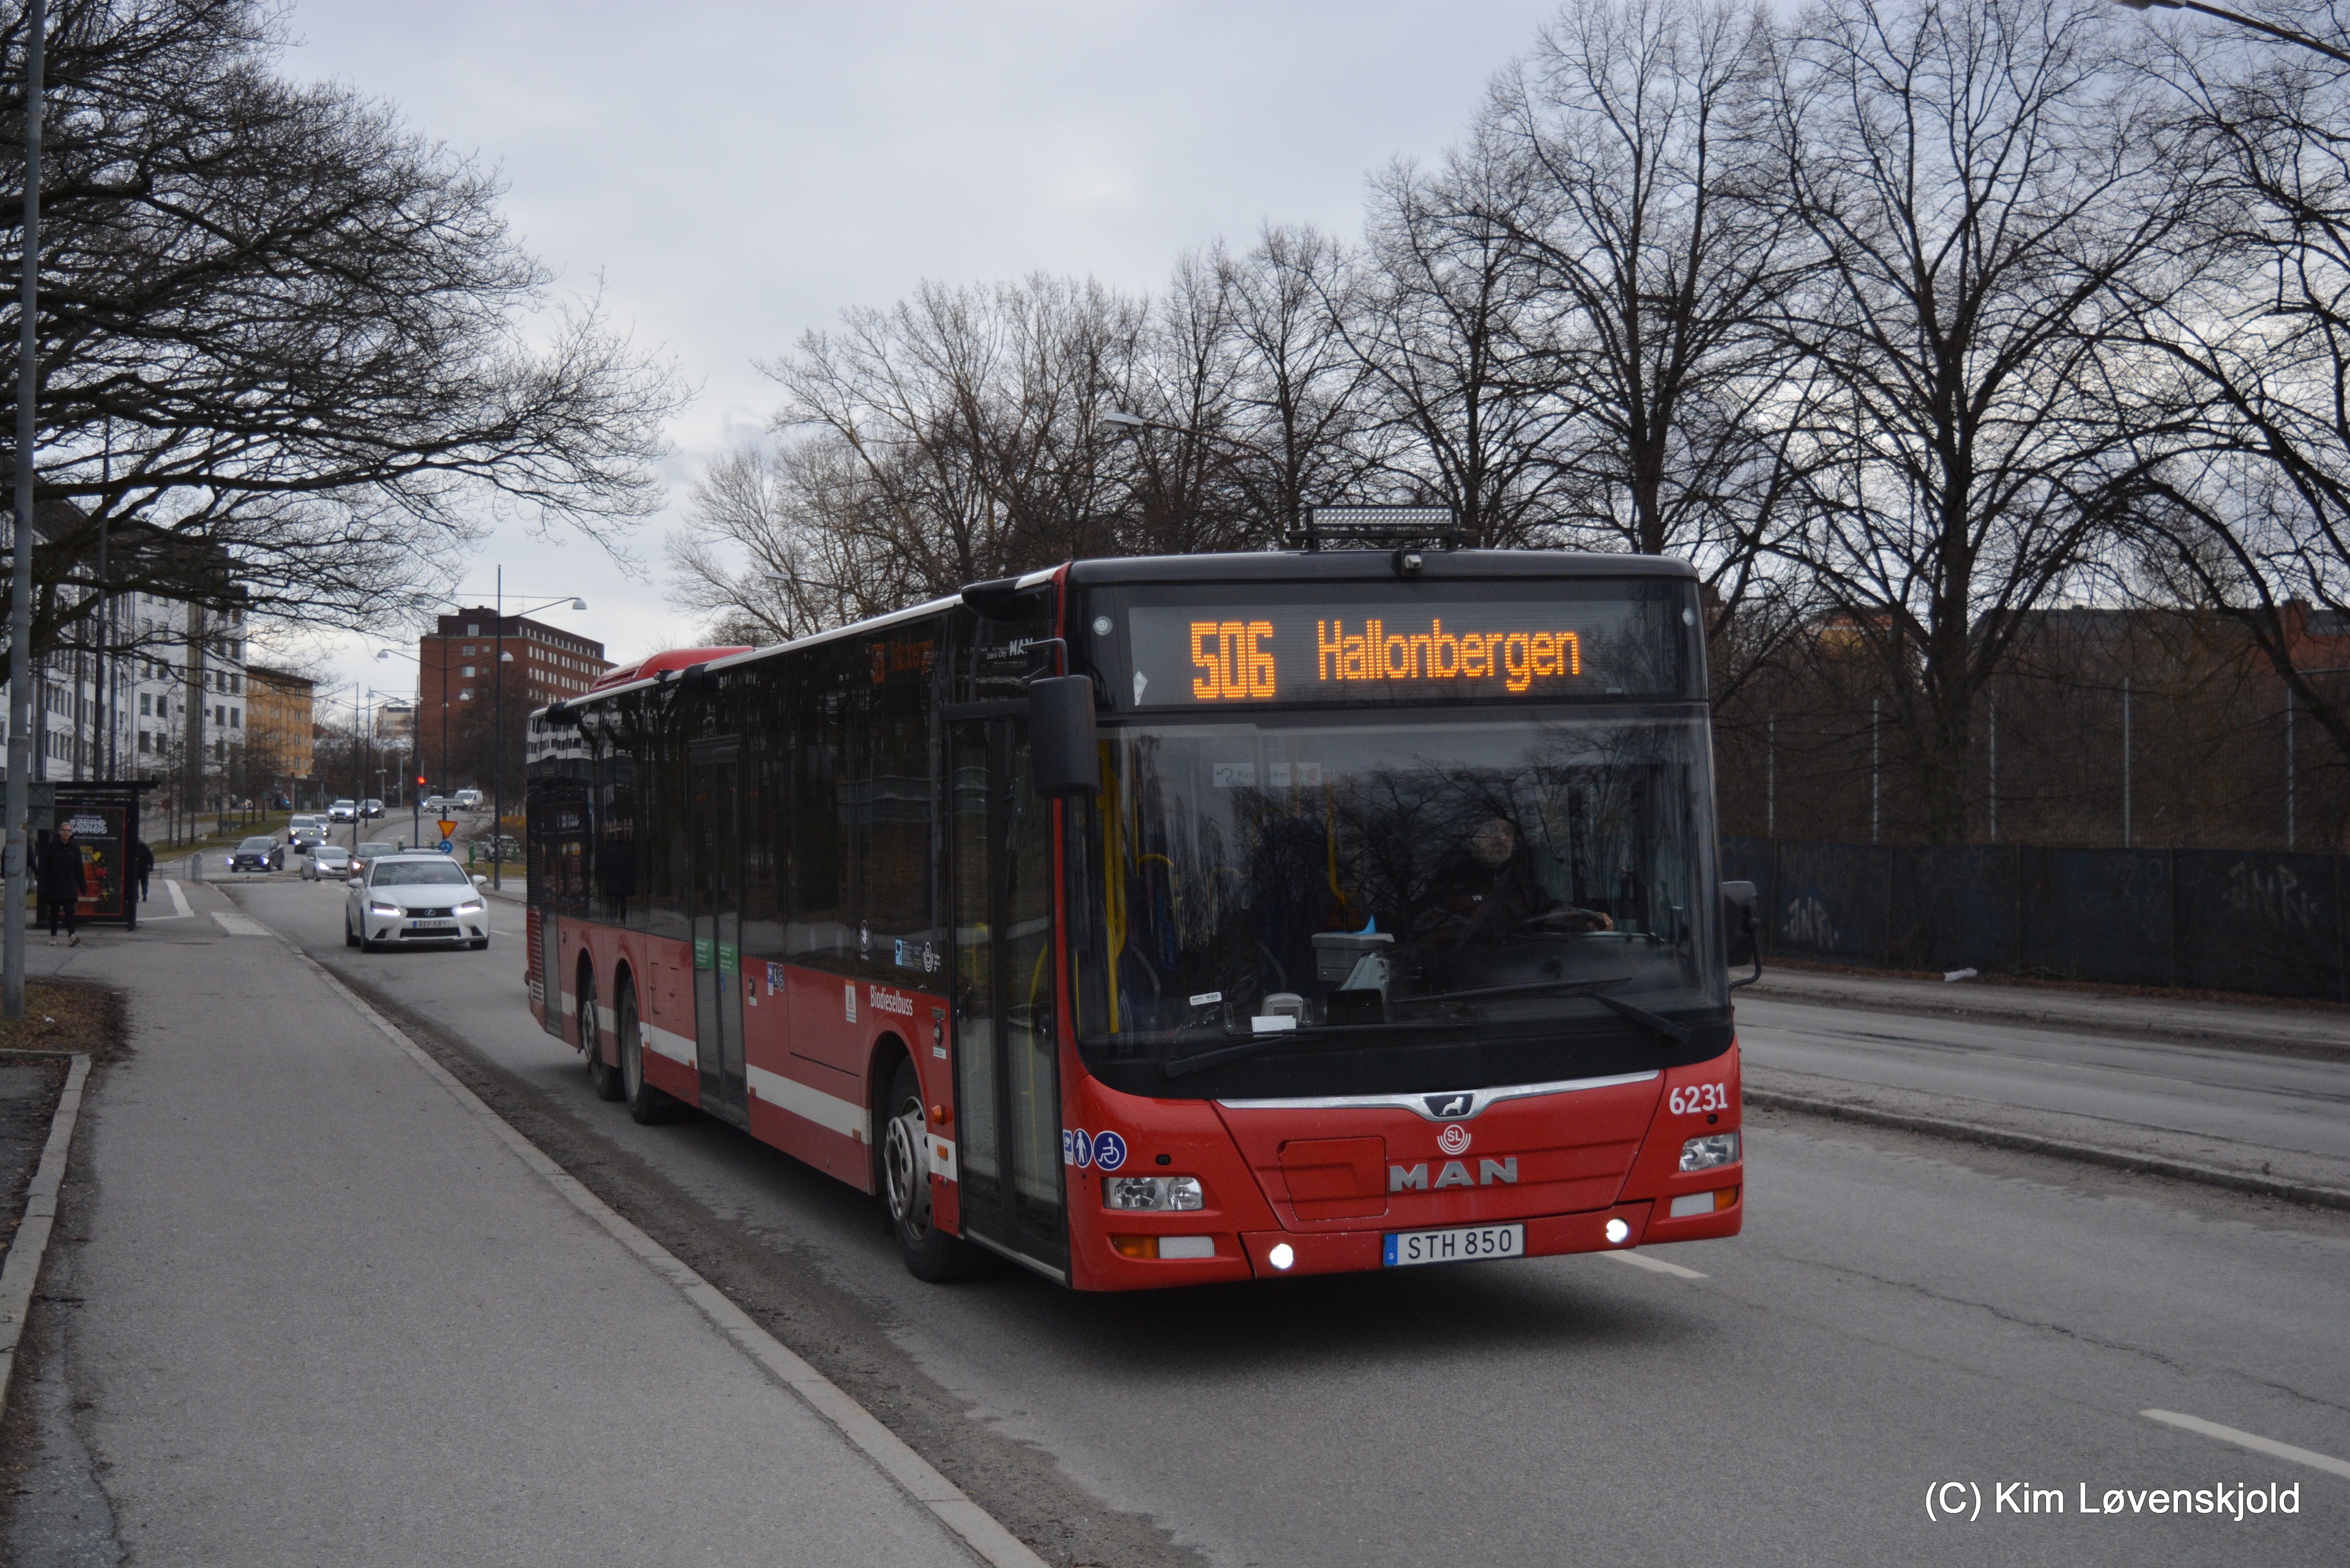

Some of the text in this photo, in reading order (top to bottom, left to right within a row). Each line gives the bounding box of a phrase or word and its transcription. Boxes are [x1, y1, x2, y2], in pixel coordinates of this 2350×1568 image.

[998, 649, 1007, 659] City
[1191, 619, 1580, 698] 506 Hallonbergen
[870, 984, 913, 1017] Biodieselbuss
[1669, 1083, 1728, 1114] 6231
[1447, 1130, 1461, 1142] SL
[1389, 1157, 1518, 1192] MAN
[1408, 1233, 1455, 1260] STH
[1465, 1229, 1512, 1255] 850
